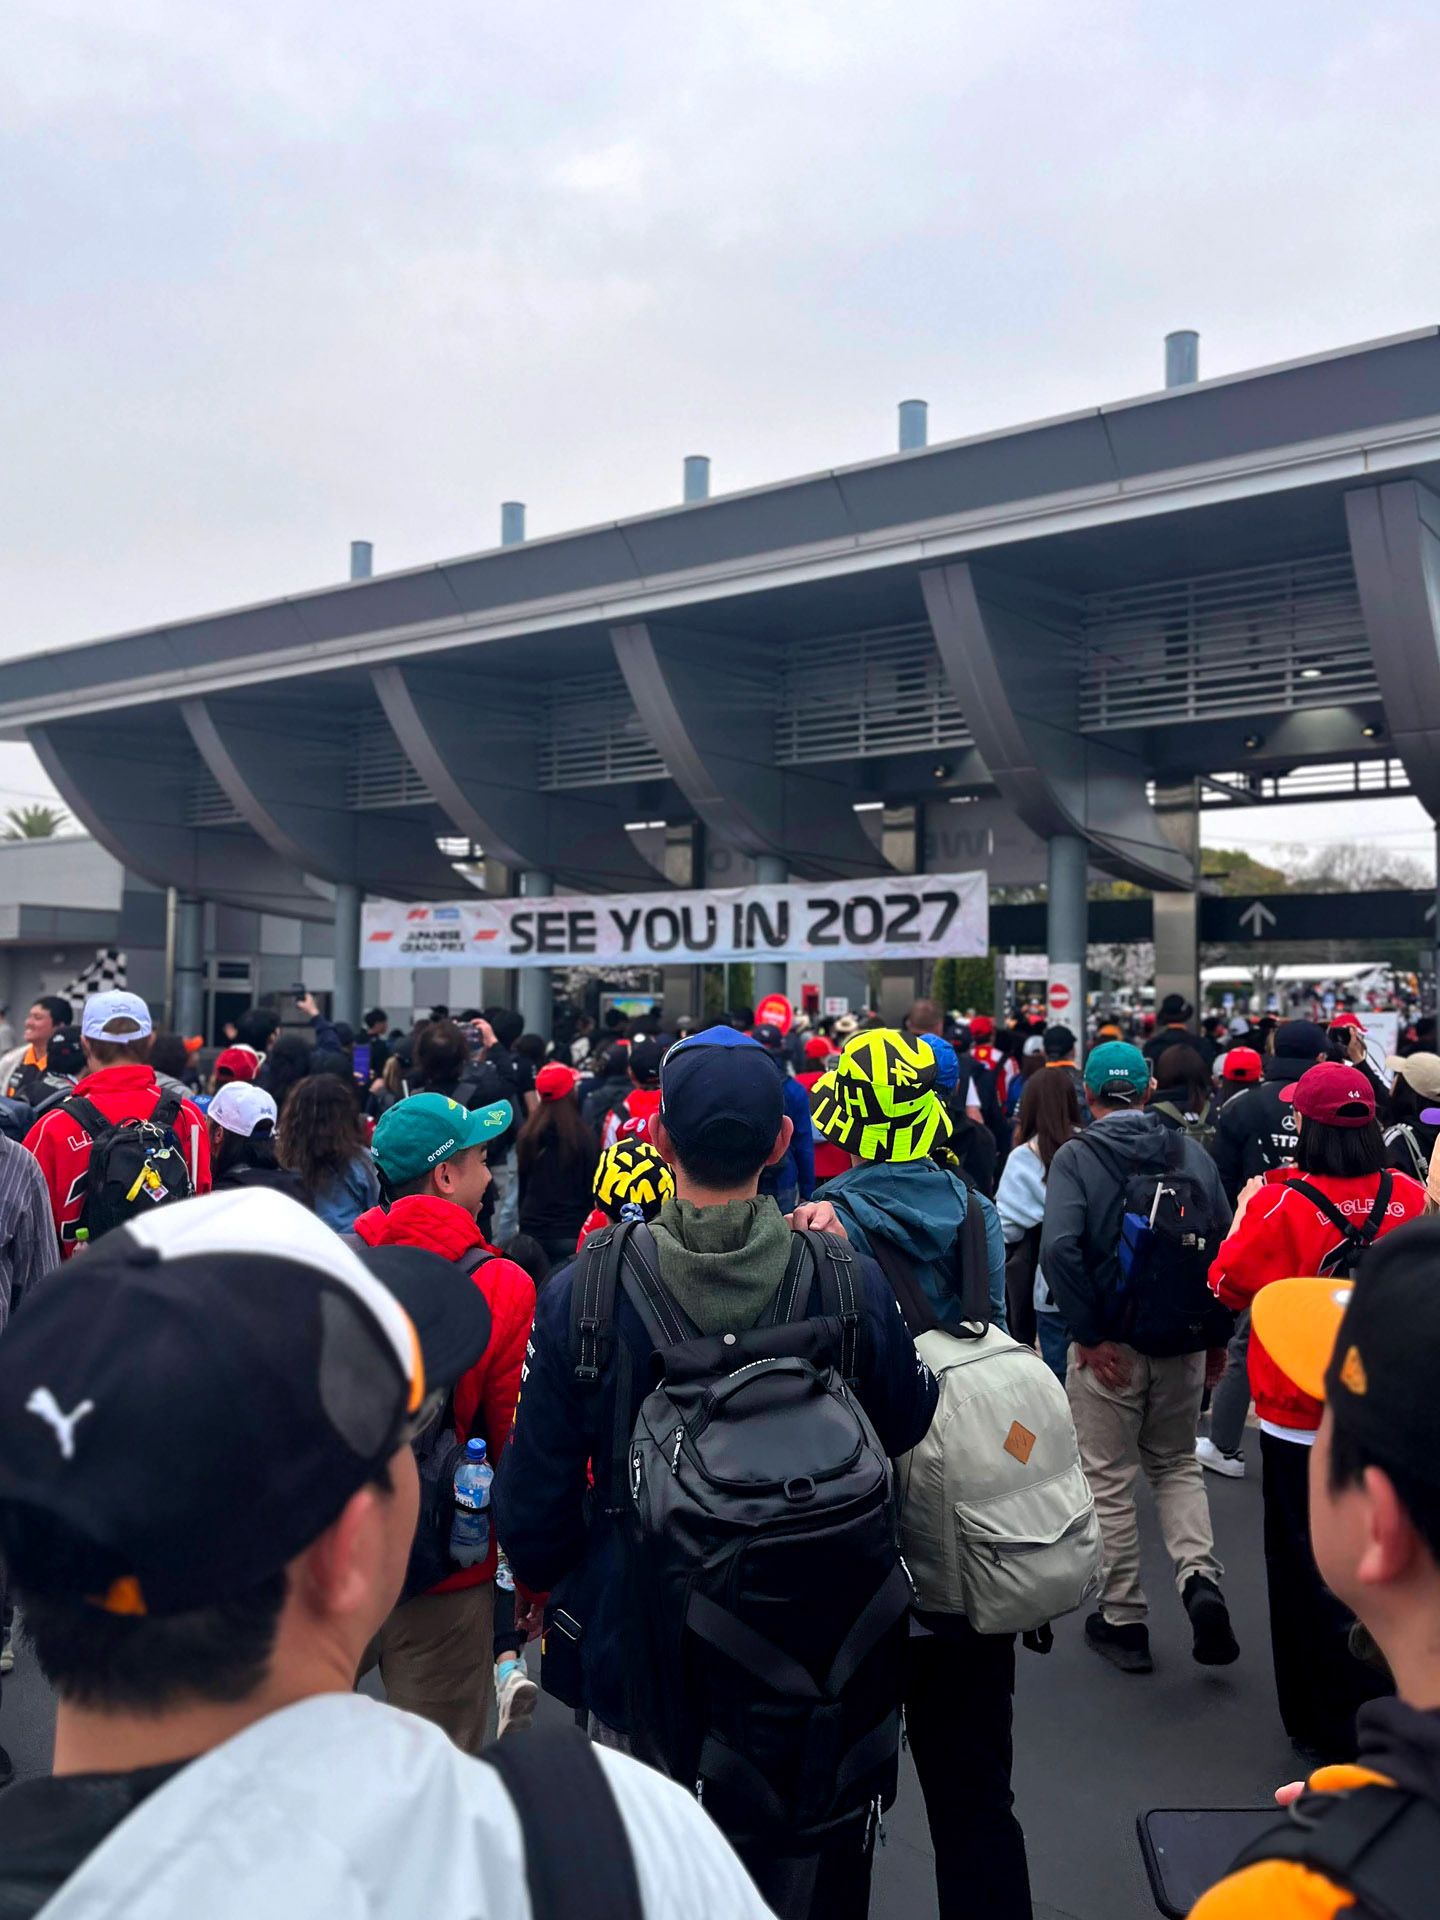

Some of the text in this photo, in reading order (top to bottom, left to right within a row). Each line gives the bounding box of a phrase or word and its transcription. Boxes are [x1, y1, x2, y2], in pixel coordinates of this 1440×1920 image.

[509, 891, 961, 954] SEE YOU IN 2027
[407, 930, 461, 941] JAPANESE
[400, 942, 466, 953] GRAND PRIX
[1348, 1090, 1360, 1098] 44
[484, 1110, 506, 1126] 14
[427, 1138, 455, 1162] aramco
[1315, 1198, 1405, 1226] LCLEC
